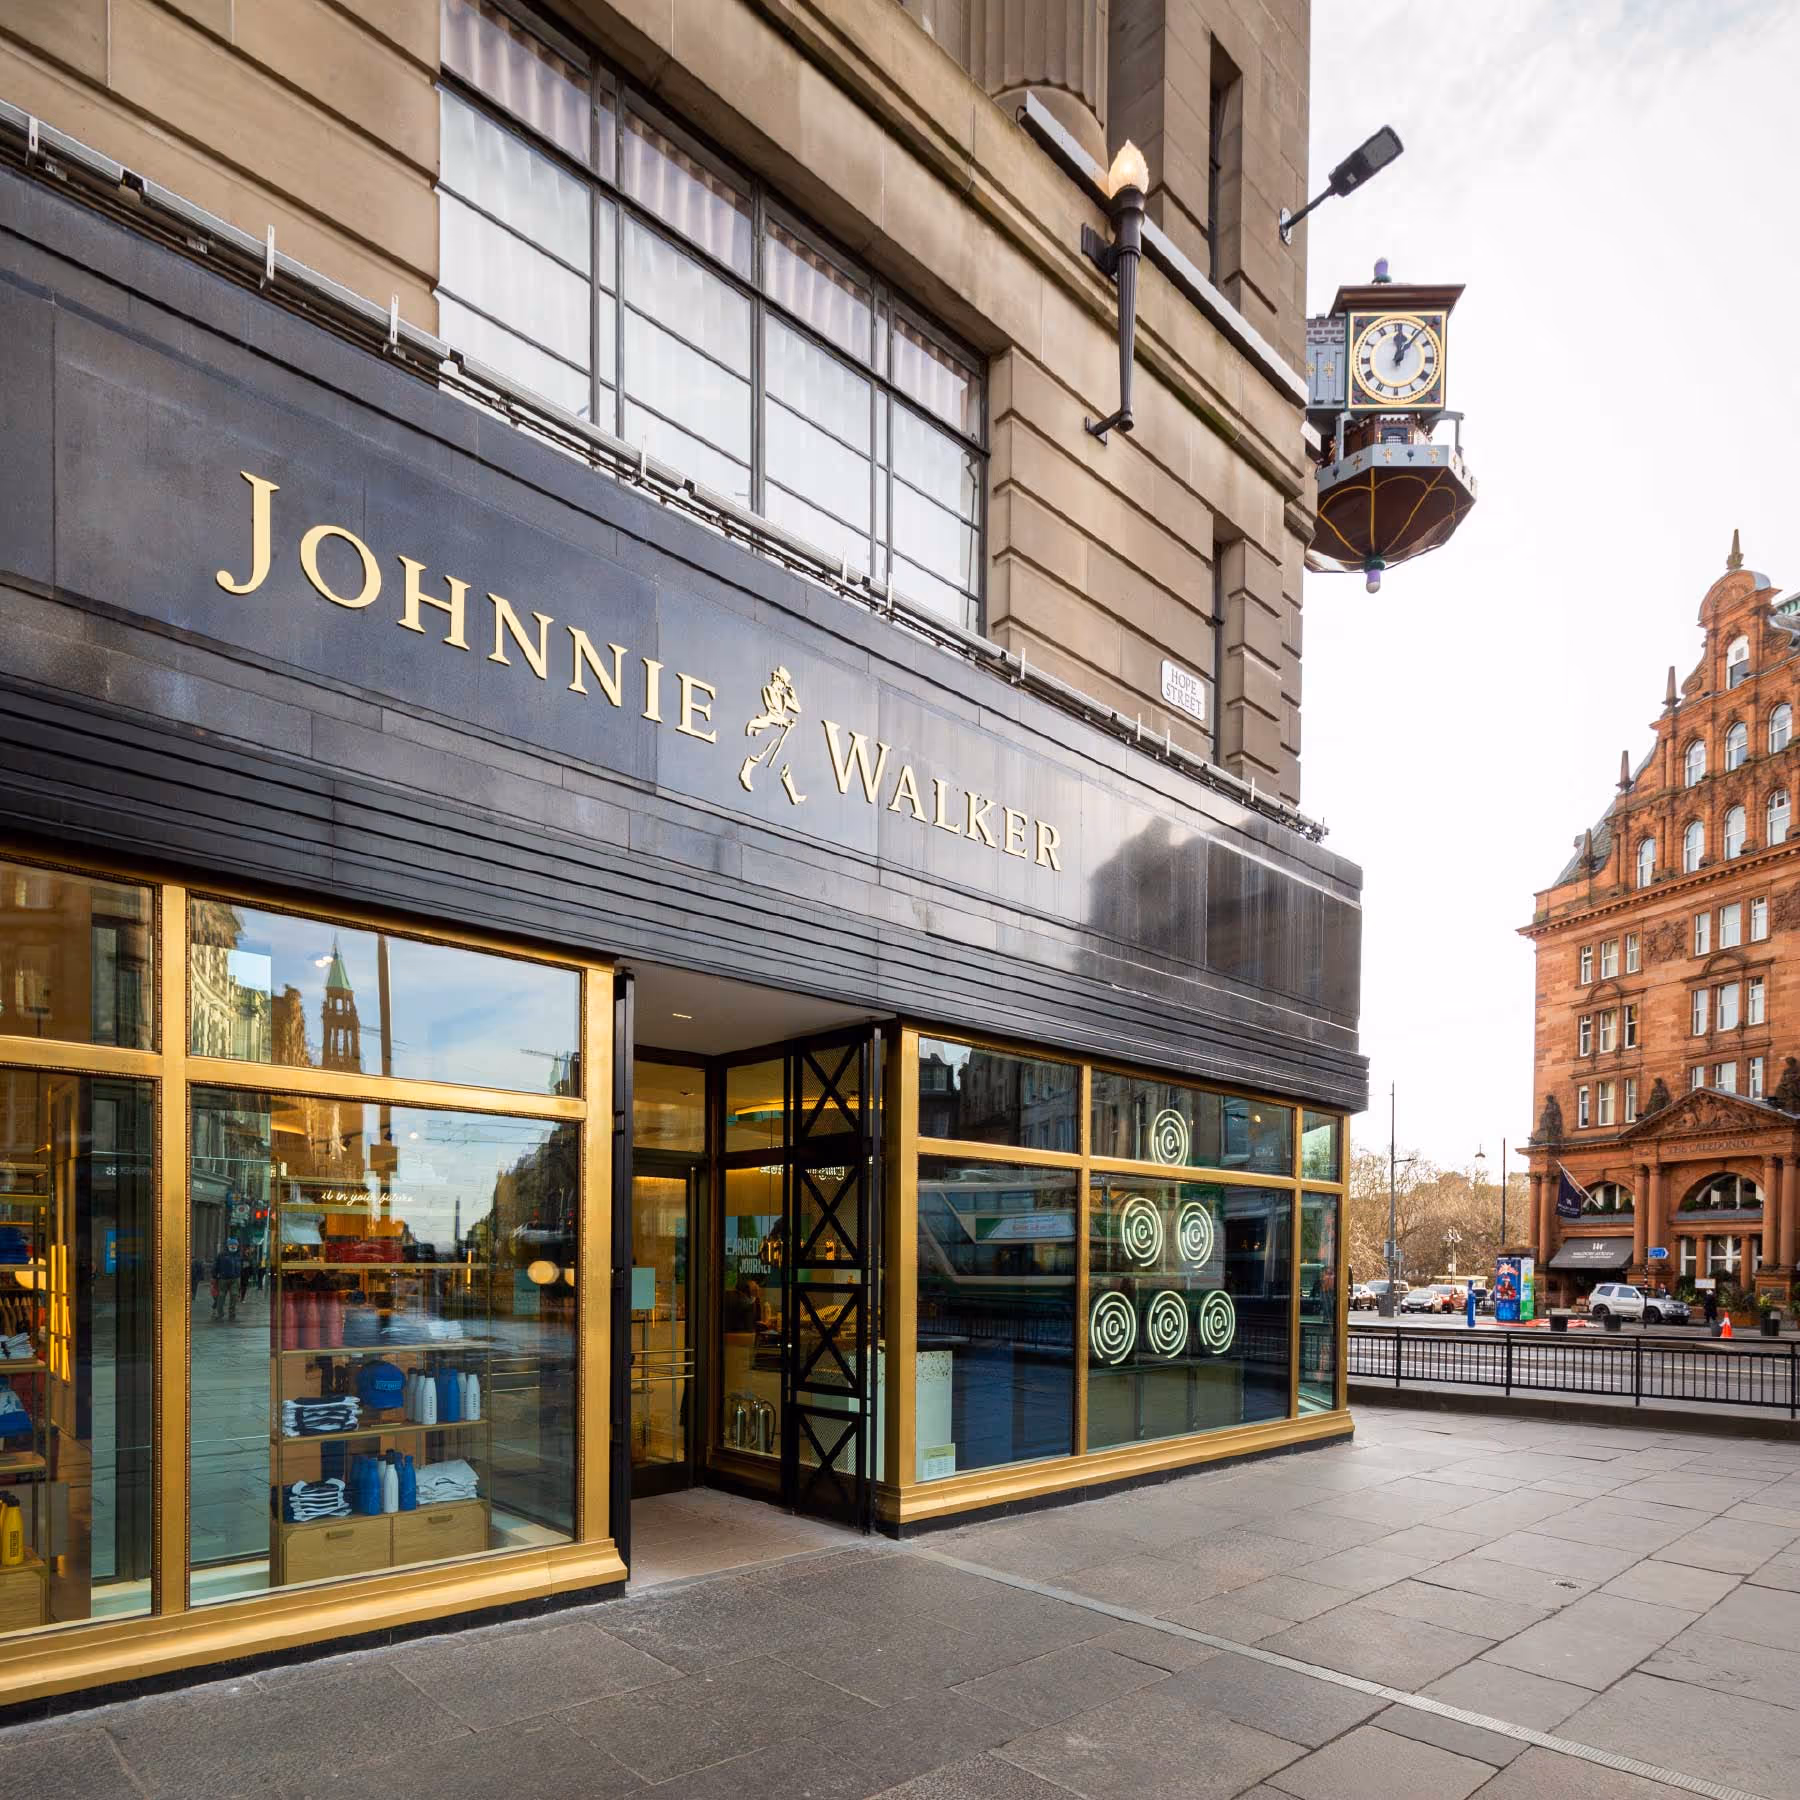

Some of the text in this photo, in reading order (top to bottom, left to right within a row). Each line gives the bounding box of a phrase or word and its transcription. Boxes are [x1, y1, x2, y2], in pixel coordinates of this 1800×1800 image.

[215, 469, 1062, 872] JOHNNIE WALKER
[1171, 668, 1197, 696] HOPE
[1166, 682, 1202, 715] STREET
